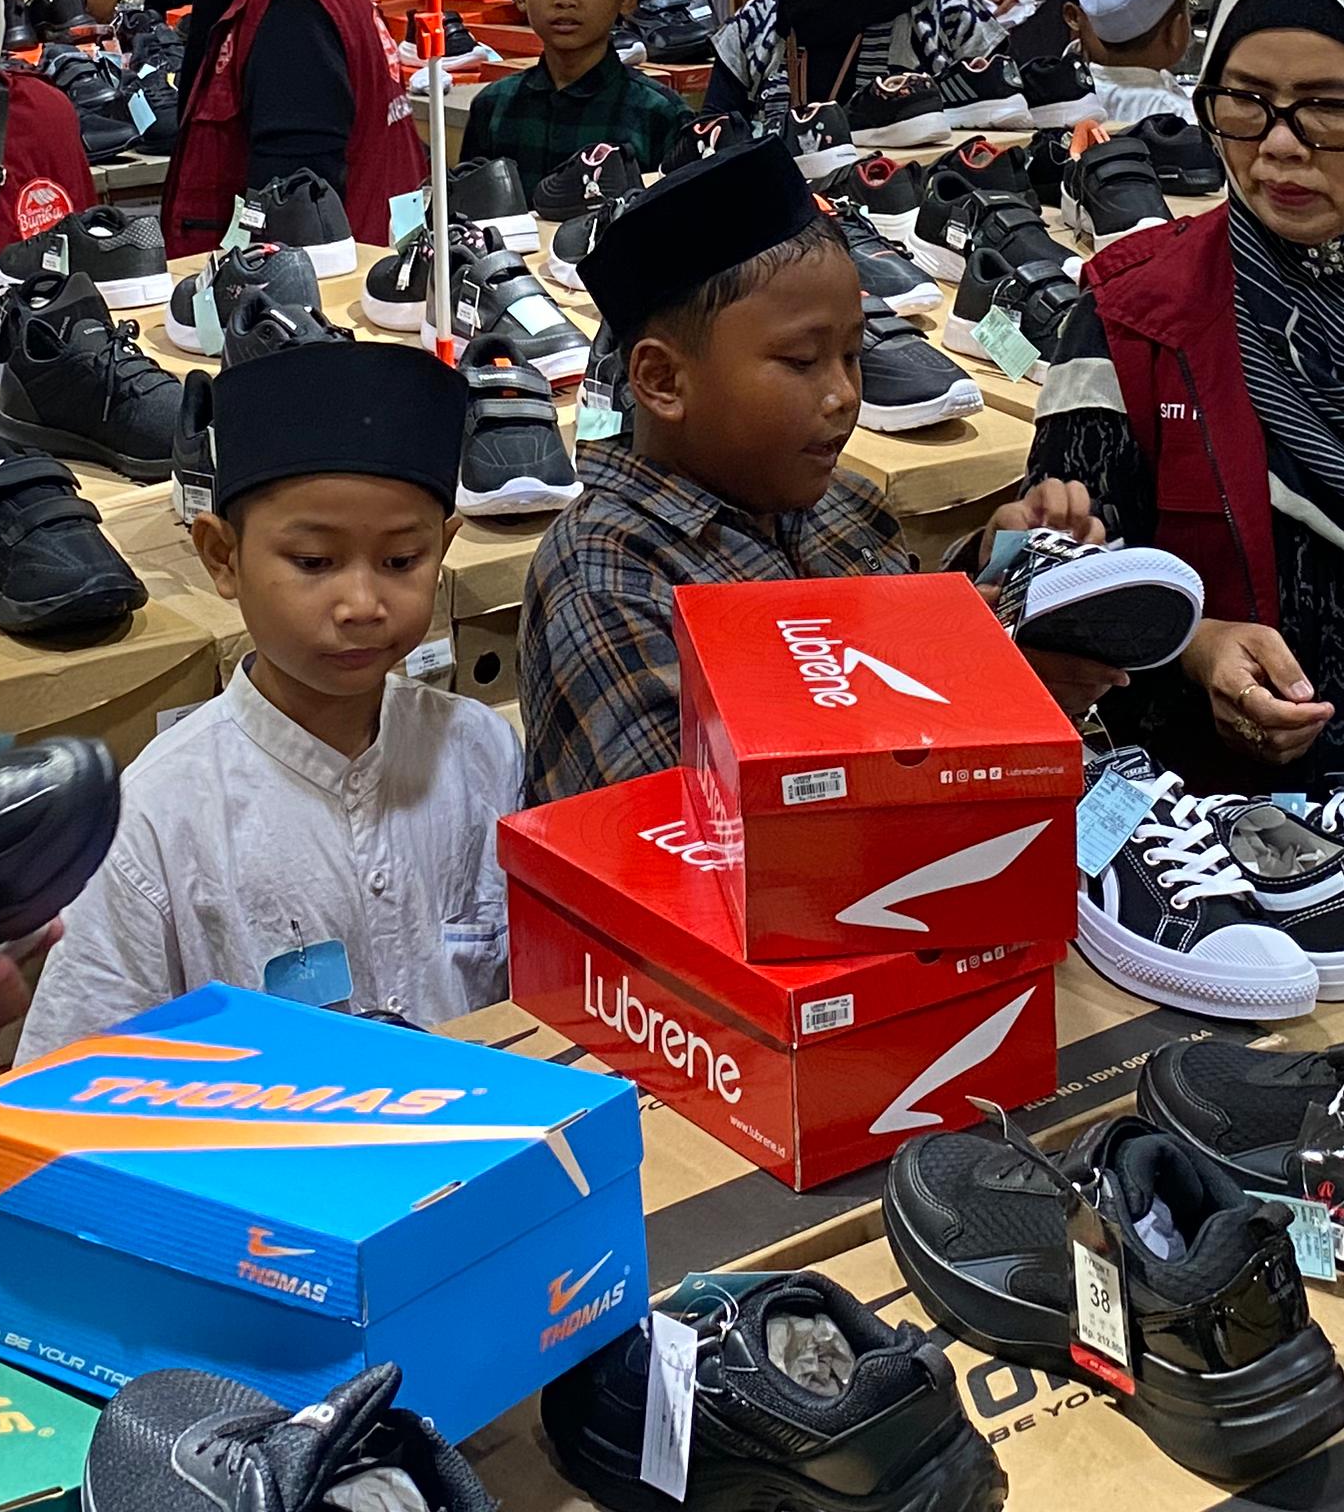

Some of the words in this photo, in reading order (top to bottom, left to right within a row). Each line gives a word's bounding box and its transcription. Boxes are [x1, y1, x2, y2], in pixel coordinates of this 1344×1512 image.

[1160, 403, 1185, 419] SITI
[776, 617, 858, 709] Lubrene
[582, 951, 743, 1105] Lubrene
[1086, 1064, 1124, 1084] IDM
[68, 1075, 468, 1117] THOMAS
[237, 1260, 328, 1306] THOMAS
[1090, 1282, 1112, 1314] 38
[539, 1274, 627, 1353] THOMAS
[4, 1332, 33, 1351] BE
[37, 1342, 86, 1371] YOUR
[987, 1413, 1037, 1445] BE
